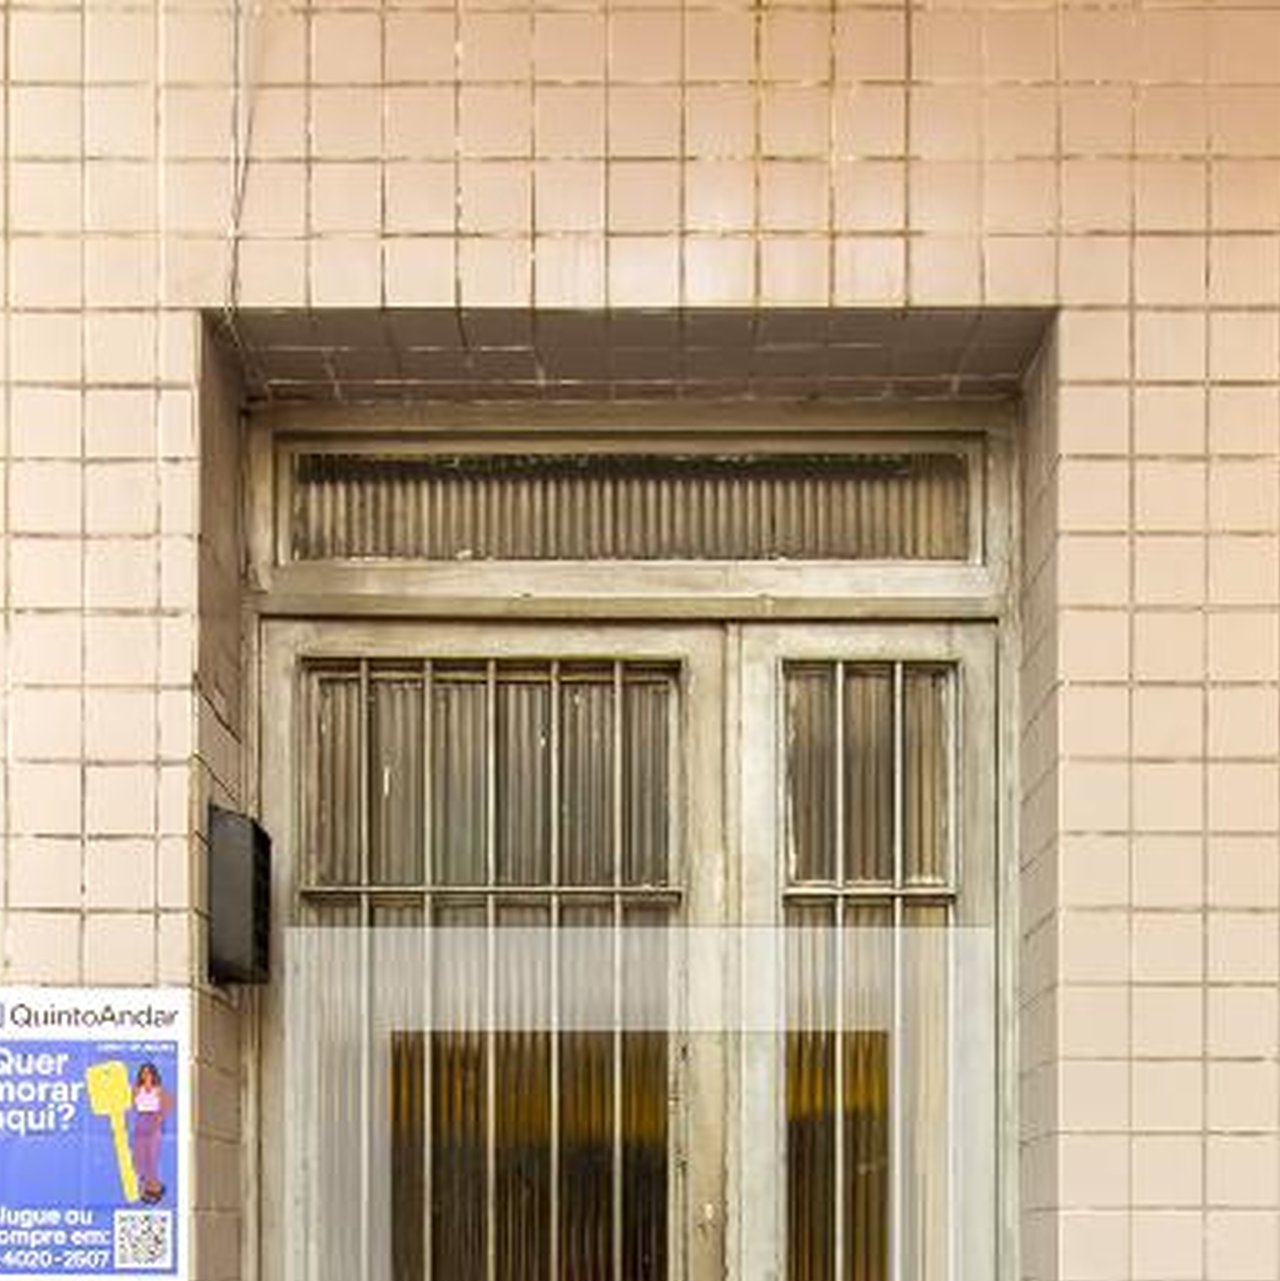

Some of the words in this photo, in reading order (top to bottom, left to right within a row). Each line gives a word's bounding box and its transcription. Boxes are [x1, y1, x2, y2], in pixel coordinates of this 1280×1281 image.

[10, 1003, 179, 1028] QuintoAndar
[64, 1209, 93, 1225] ou
[70, 1229, 111, 1246] em:
